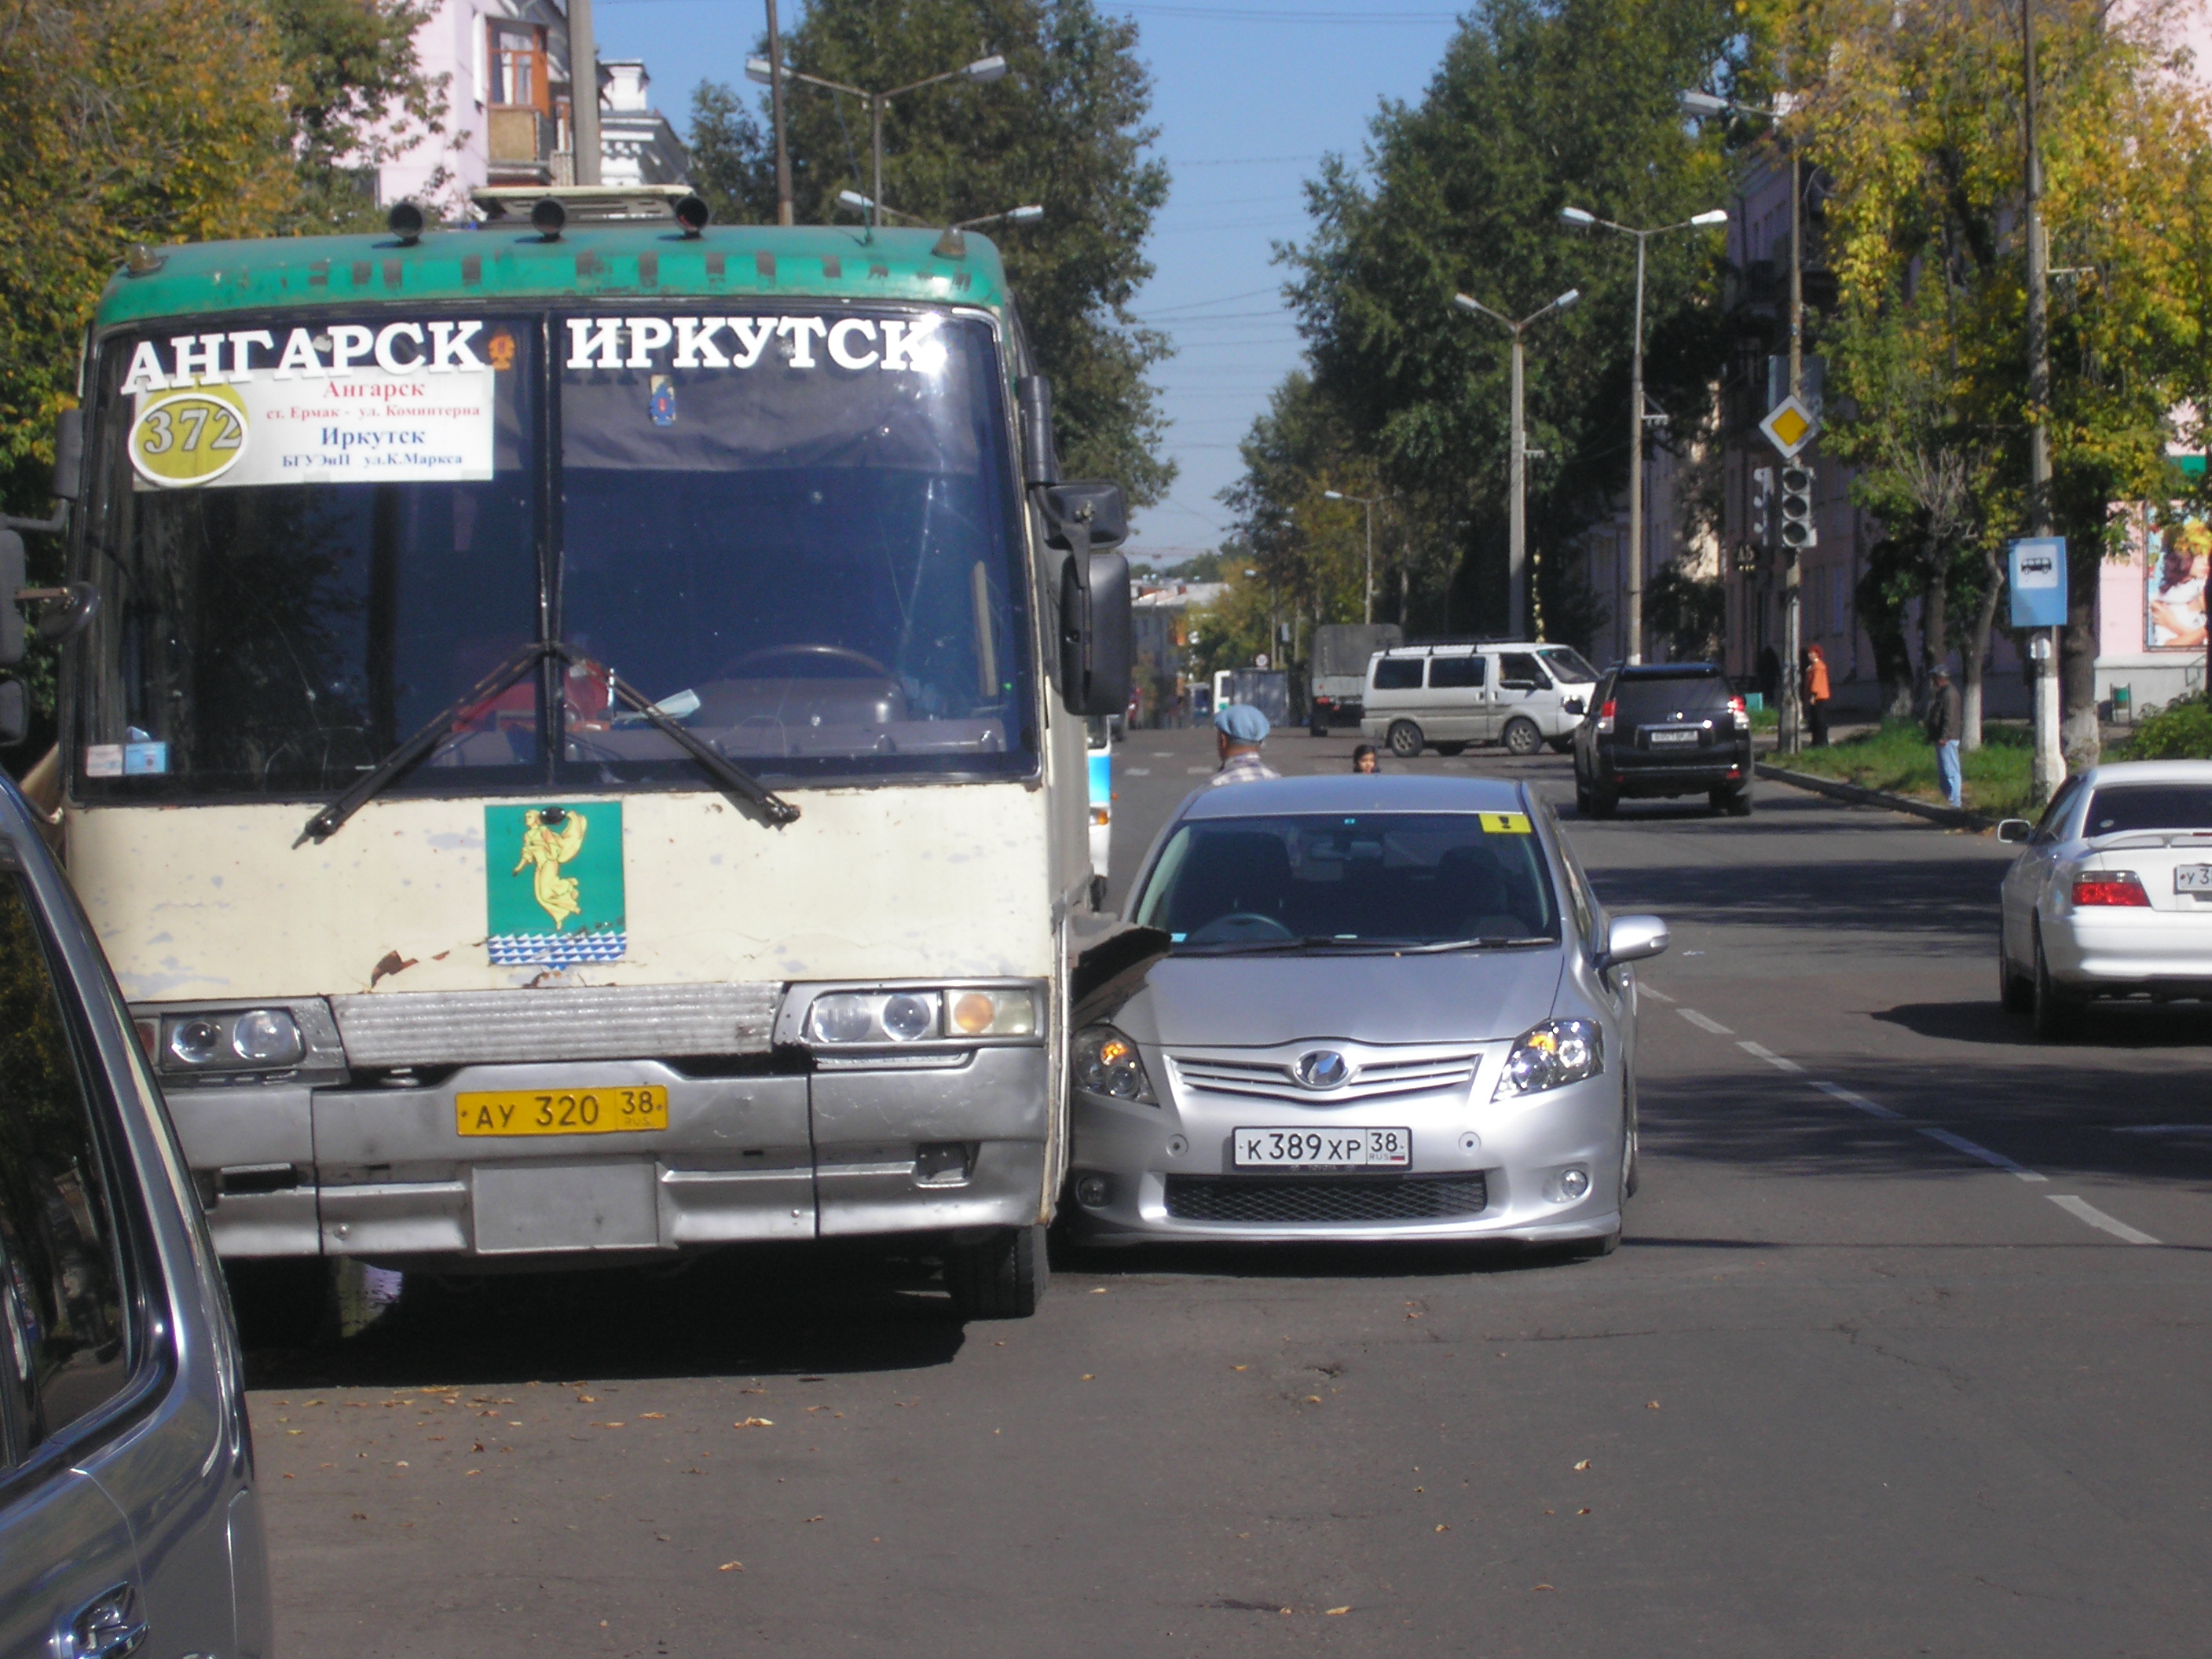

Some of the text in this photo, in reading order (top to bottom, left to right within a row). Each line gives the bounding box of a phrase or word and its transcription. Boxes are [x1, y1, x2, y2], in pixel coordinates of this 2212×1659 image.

[566, 316, 945, 372] ИРКУТСК
[121, 320, 486, 396] АНГАРСК
[324, 380, 426, 402] Ангарск
[266, 409, 285, 419] ст.
[291, 405, 339, 421] Ермак
[359, 408, 380, 420] ул.
[386, 404, 480, 419] Коминтерна
[143, 406, 243, 456] 372
[321, 427, 426, 450] Иркутск
[535, 1093, 599, 1127] 320
[621, 1090, 654, 1115] 38
[1370, 1132, 1397, 1152] 38
[1369, 1152, 1390, 1161] RUS
